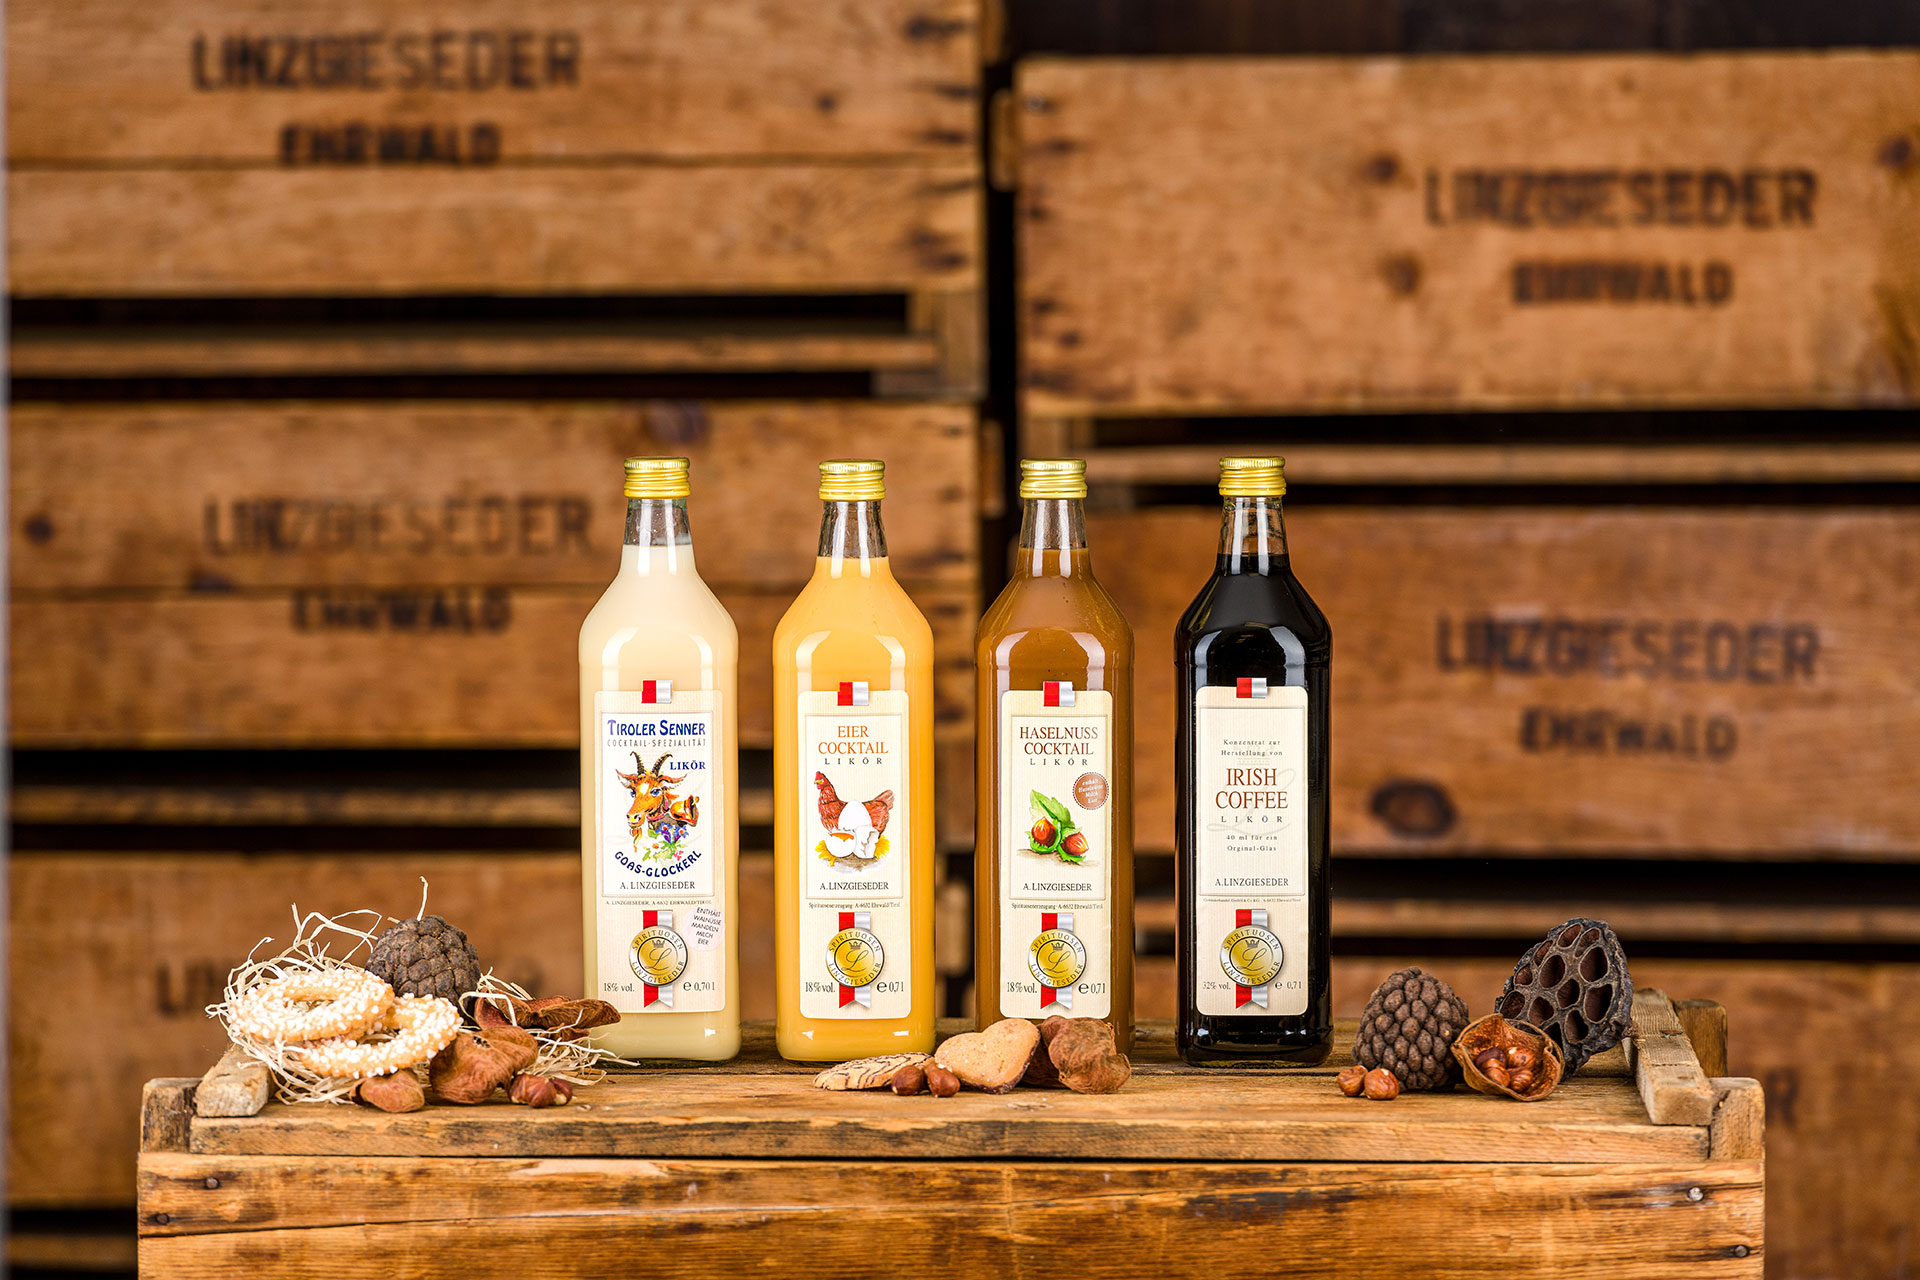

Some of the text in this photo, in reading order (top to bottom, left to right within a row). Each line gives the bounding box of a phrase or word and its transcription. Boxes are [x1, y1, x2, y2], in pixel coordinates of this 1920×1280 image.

[190, 29, 581, 92] LINZGIESEDER
[1425, 167, 1818, 231] LINZGIESEDER
[204, 496, 594, 557] LINZGIESEDER
[1436, 616, 1820, 684] LINZGIESEDER
[608, 719, 706, 736] TIROLER SENNER
[838, 725, 869, 738] EIER
[1020, 726, 1098, 739] HASELNUSS
[607, 738, 706, 747] COCKTAIL-SPEZIALITÄT
[818, 742, 888, 754] COCKTAIL
[1024, 742, 1094, 755] COCKTAIL
[670, 760, 706, 770] LIKÖR
[1226, 768, 1278, 786] IRISH
[1215, 791, 1289, 809] COFFEE
[614, 851, 702, 878] GOAS-GLOCKERL
[631, 881, 696, 890] LINZGIESEDER
[632, 929, 684, 951] SPIRITUOSEN
[829, 931, 881, 953] SPIRITUOSEN
[1031, 932, 1083, 954] SPIRITUOSEN
[1223, 929, 1280, 951] SPIRITUOSEN
[632, 960, 685, 984] LINZGIESEDER
[829, 962, 881, 985] LINZGIESEDER
[1031, 963, 1083, 987] LINZGIESEDER
[1223, 961, 1281, 984] LINZGIESEDER
